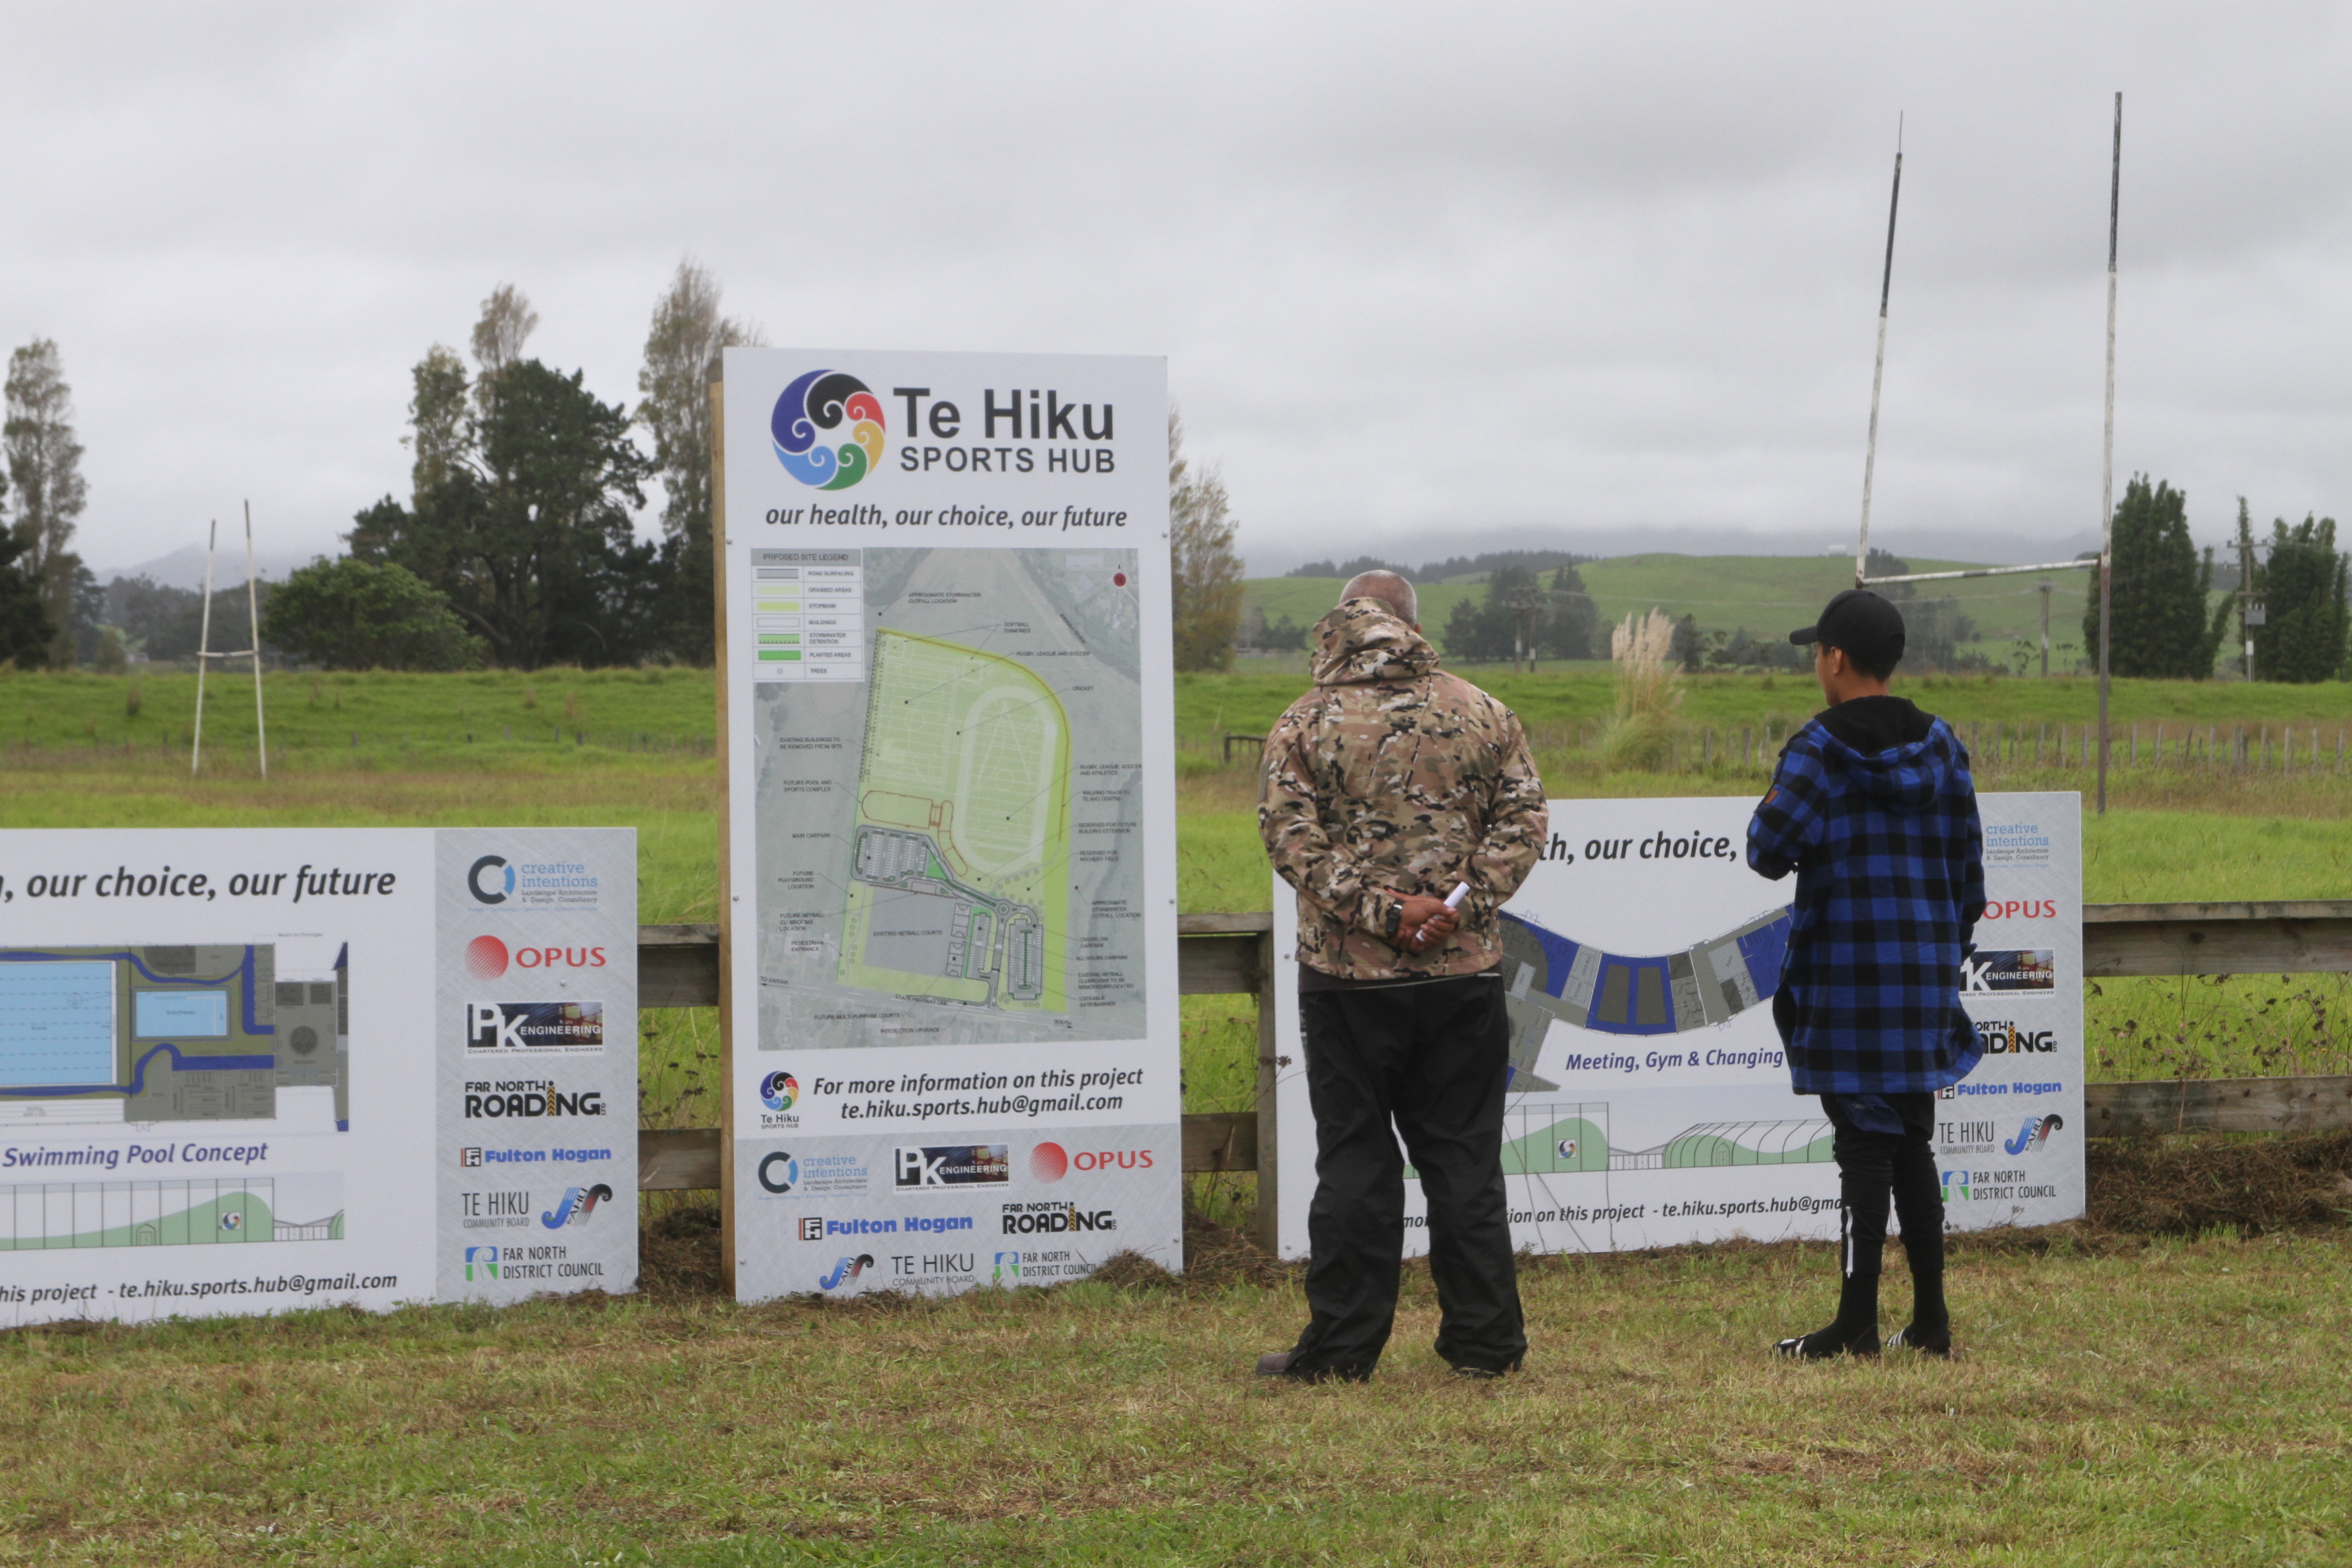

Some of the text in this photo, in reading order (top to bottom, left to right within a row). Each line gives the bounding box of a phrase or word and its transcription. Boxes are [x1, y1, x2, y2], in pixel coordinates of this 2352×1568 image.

[893, 387, 1114, 441] Te Hiku
[900, 447, 1115, 473] SPORTS HUB
[766, 504, 1127, 531] our health, our choice, our future
[1987, 822, 2038, 834] creative
[1584, 838, 1633, 860] our
[1639, 830, 1737, 862] choice,
[1987, 835, 2049, 847] intentions
[521, 861, 585, 874] creative
[27, 875, 87, 897] our
[95, 866, 216, 900] choice,
[229, 872, 287, 896] our
[293, 865, 396, 904] future
[522, 875, 598, 887] intentions
[1982, 900, 2057, 919] OPUS
[516, 947, 606, 968] OPUS
[1986, 971, 2053, 981] ENGINEERING
[520, 1025, 601, 1036] ENGINEERING
[1972, 1021, 2007, 1031] ORTH
[1980, 1021, 2053, 1054] DING
[1566, 1048, 1784, 1073] Meeting, Gym & Changing
[465, 1081, 545, 1092] FAR NORTH
[813, 1068, 1143, 1096] For more information on this project
[1958, 1082, 2061, 1096] Fulton Hogan
[841, 1093, 1122, 1120] te.hiku.sports.hub@gmail.com
[761, 1114, 799, 1123] Te Hiku
[1939, 1121, 1995, 1143] TE HIKU
[2, 1142, 268, 1169] Swimming Pool Concept
[485, 1149, 546, 1162] Fulton
[552, 1148, 611, 1162] Hogan
[1940, 1145, 1995, 1155] COMMUNITY BOARD
[803, 1155, 856, 1166] creative
[1074, 1150, 1154, 1171] OPUS
[804, 1166, 867, 1177] intentions
[939, 1164, 1007, 1175] ENGINEERING
[1974, 1171, 2025, 1183] FAR NORTH
[1974, 1185, 2056, 1200] DISTRICT COUNCIL
[461, 1192, 529, 1216] TE HIKU
[1002, 1202, 1067, 1213] FAR NORTH
[1537, 1207, 1555, 1222] on
[1560, 1205, 1588, 1222] this
[1592, 1204, 1645, 1223] project
[1663, 1196, 1842, 1217] te.hiku.sports.hub@gma
[463, 1217, 529, 1228] COMMUNITY BOARD
[827, 1220, 897, 1235] Fulton
[904, 1217, 973, 1233] Hogan
[1403, 1216, 1428, 1228] mo
[504, 1246, 566, 1260] FAR NORTH
[1023, 1251, 1070, 1262] FAR NORTH
[504, 1262, 604, 1279] DISTRICT COUNCIL
[891, 1253, 974, 1275] TE HIKU
[1023, 1265, 1059, 1277] DISTRICT
[892, 1275, 975, 1286] COMMUNITY BOARD
[0, 1285, 25, 1302] his
[31, 1284, 97, 1305] project
[119, 1273, 397, 1298] te.hiku.sports.hub@gmail.com
